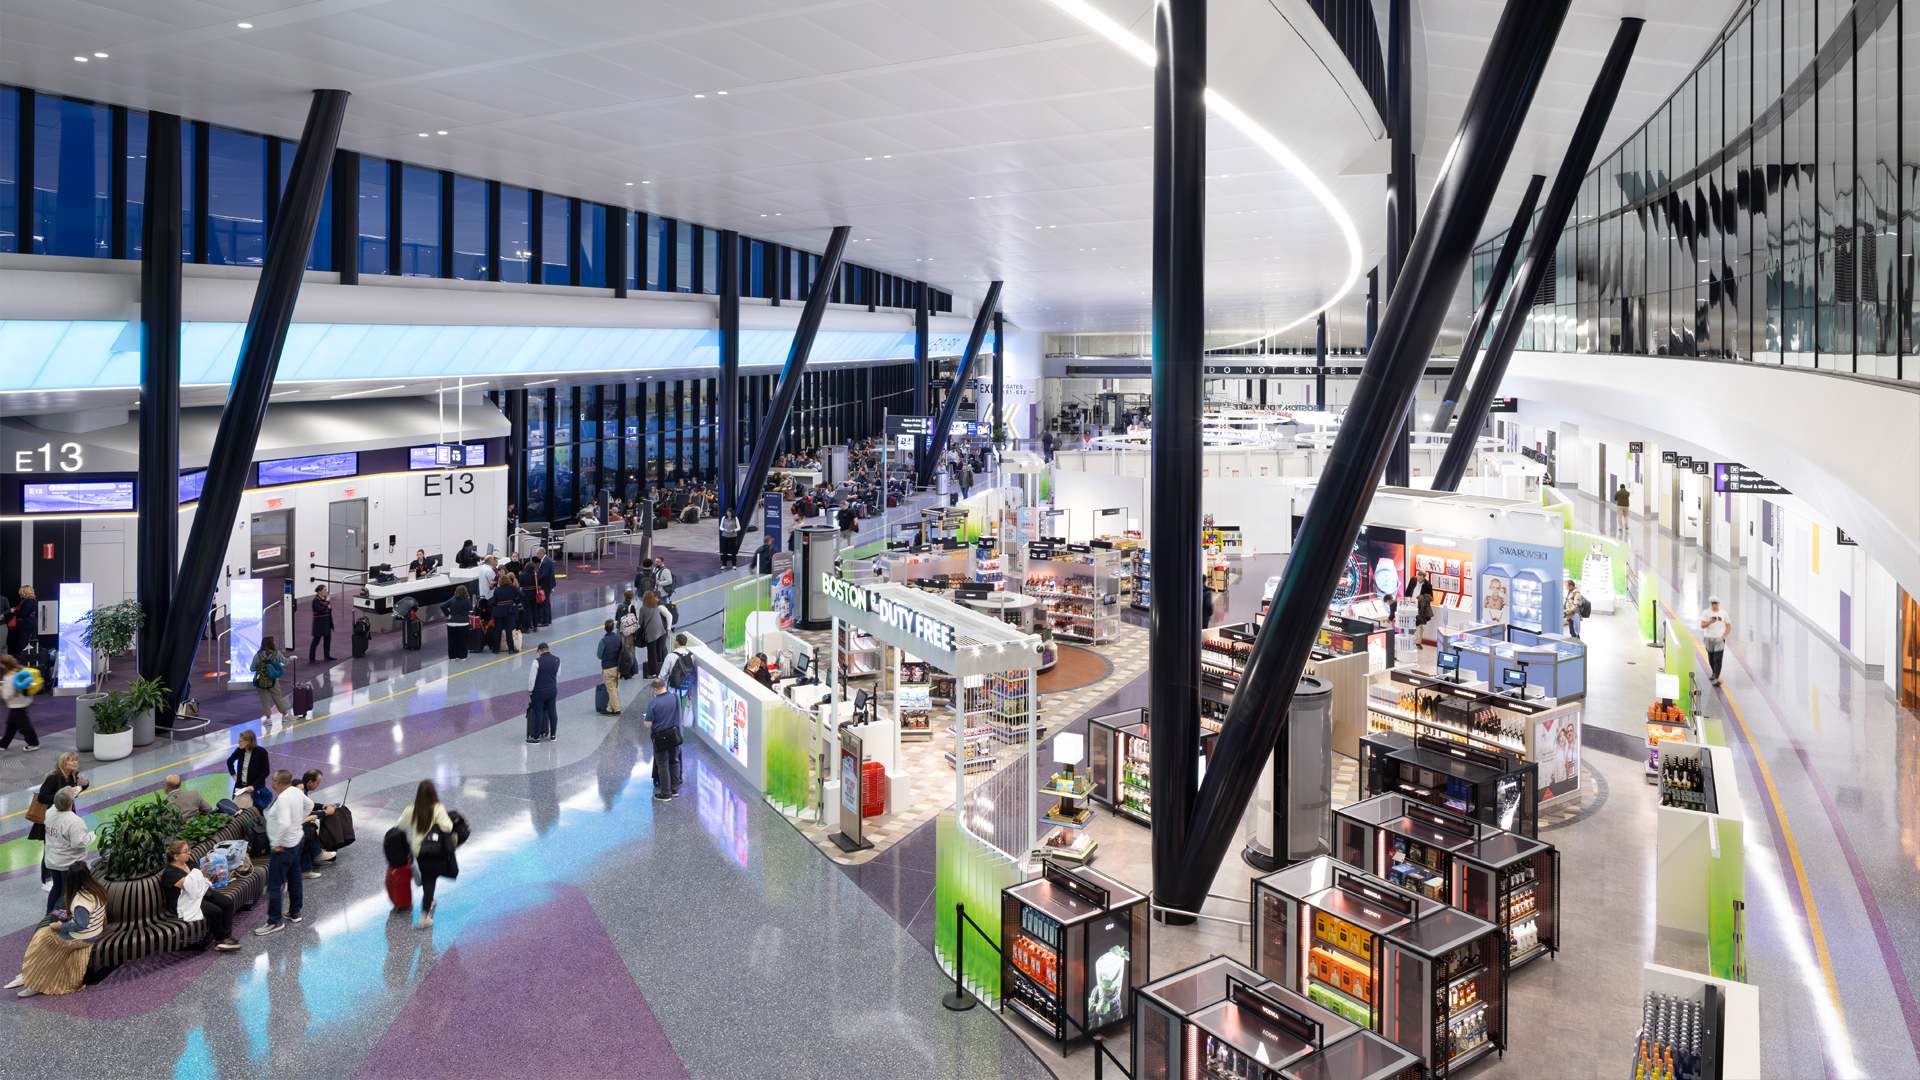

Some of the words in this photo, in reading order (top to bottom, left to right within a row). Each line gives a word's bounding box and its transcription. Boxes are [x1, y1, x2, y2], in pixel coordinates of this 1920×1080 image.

[980, 383, 993, 394] EXI
[16, 442, 83, 472] E13
[439, 448, 448, 461] E
[424, 473, 474, 496] E13
[1498, 546, 1548, 561] SWAROVSKI
[70, 586, 84, 595] E13
[239, 582, 254, 591] E13
[822, 571, 867, 612] BOSTON
[879, 598, 914, 633] DUTY
[915, 614, 952, 652] FREE
[1261, 1005, 1279, 1020] VODKA
